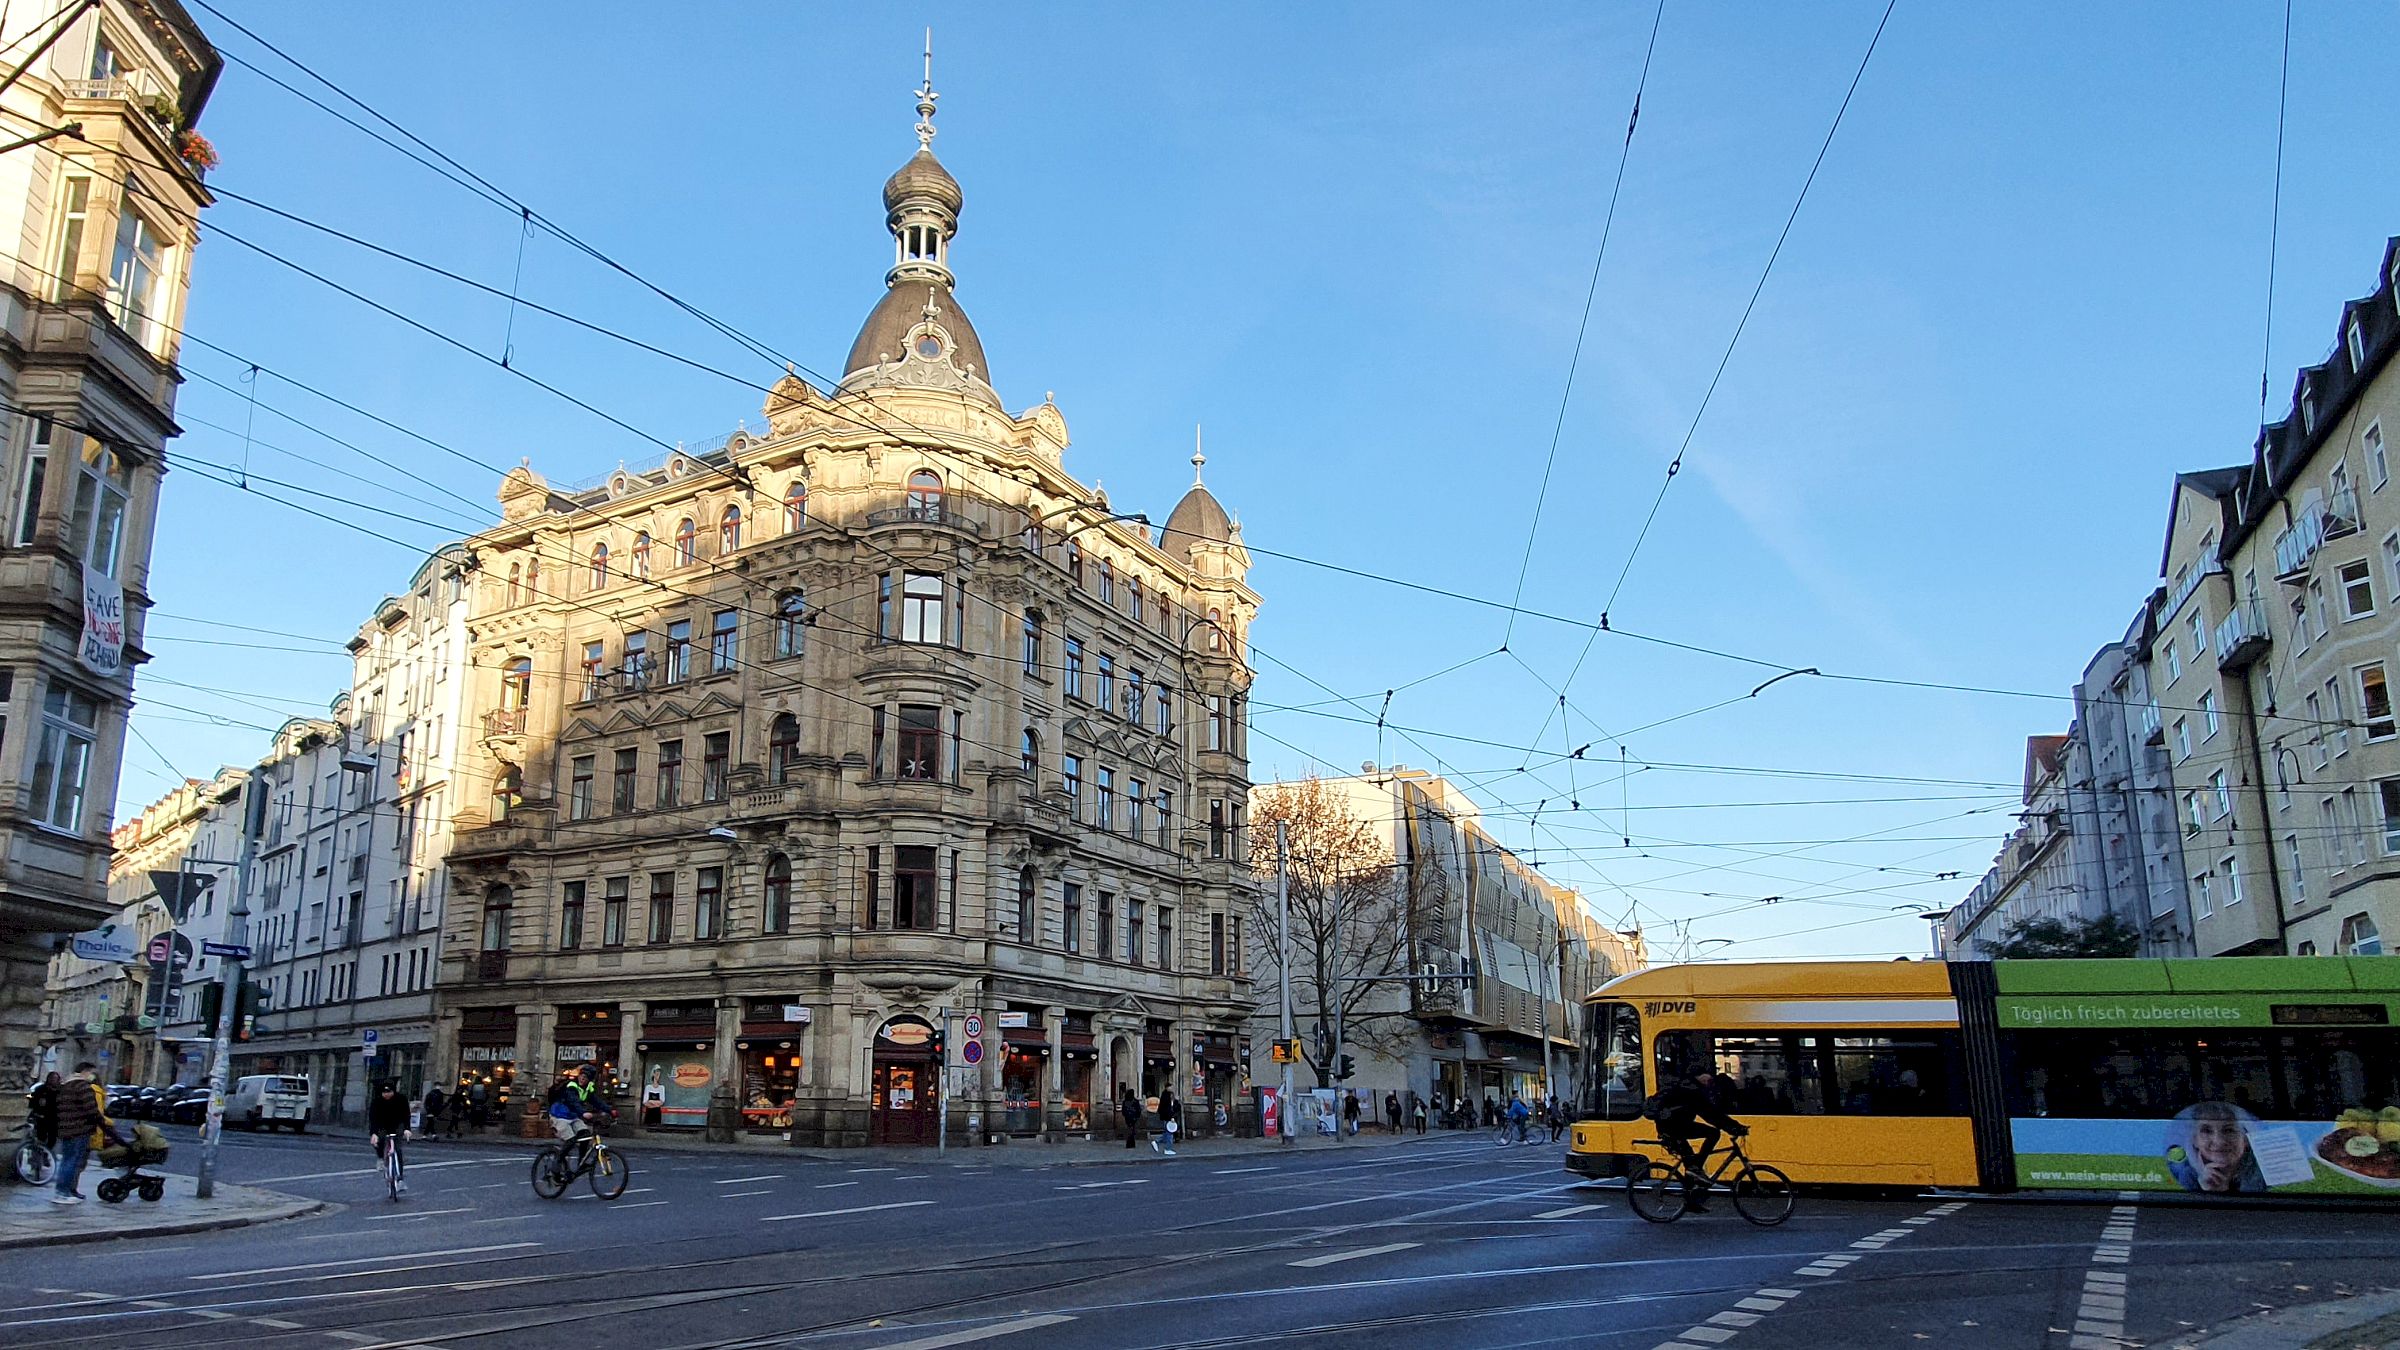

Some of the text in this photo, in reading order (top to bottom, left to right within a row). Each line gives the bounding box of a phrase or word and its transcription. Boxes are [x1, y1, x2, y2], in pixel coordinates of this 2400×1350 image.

[1662, 1001, 1696, 1013] DVB
[2077, 1004, 2126, 1020] frisch
[2131, 1004, 2241, 1020] zubereitetes
[967, 1021, 979, 1032] 30
